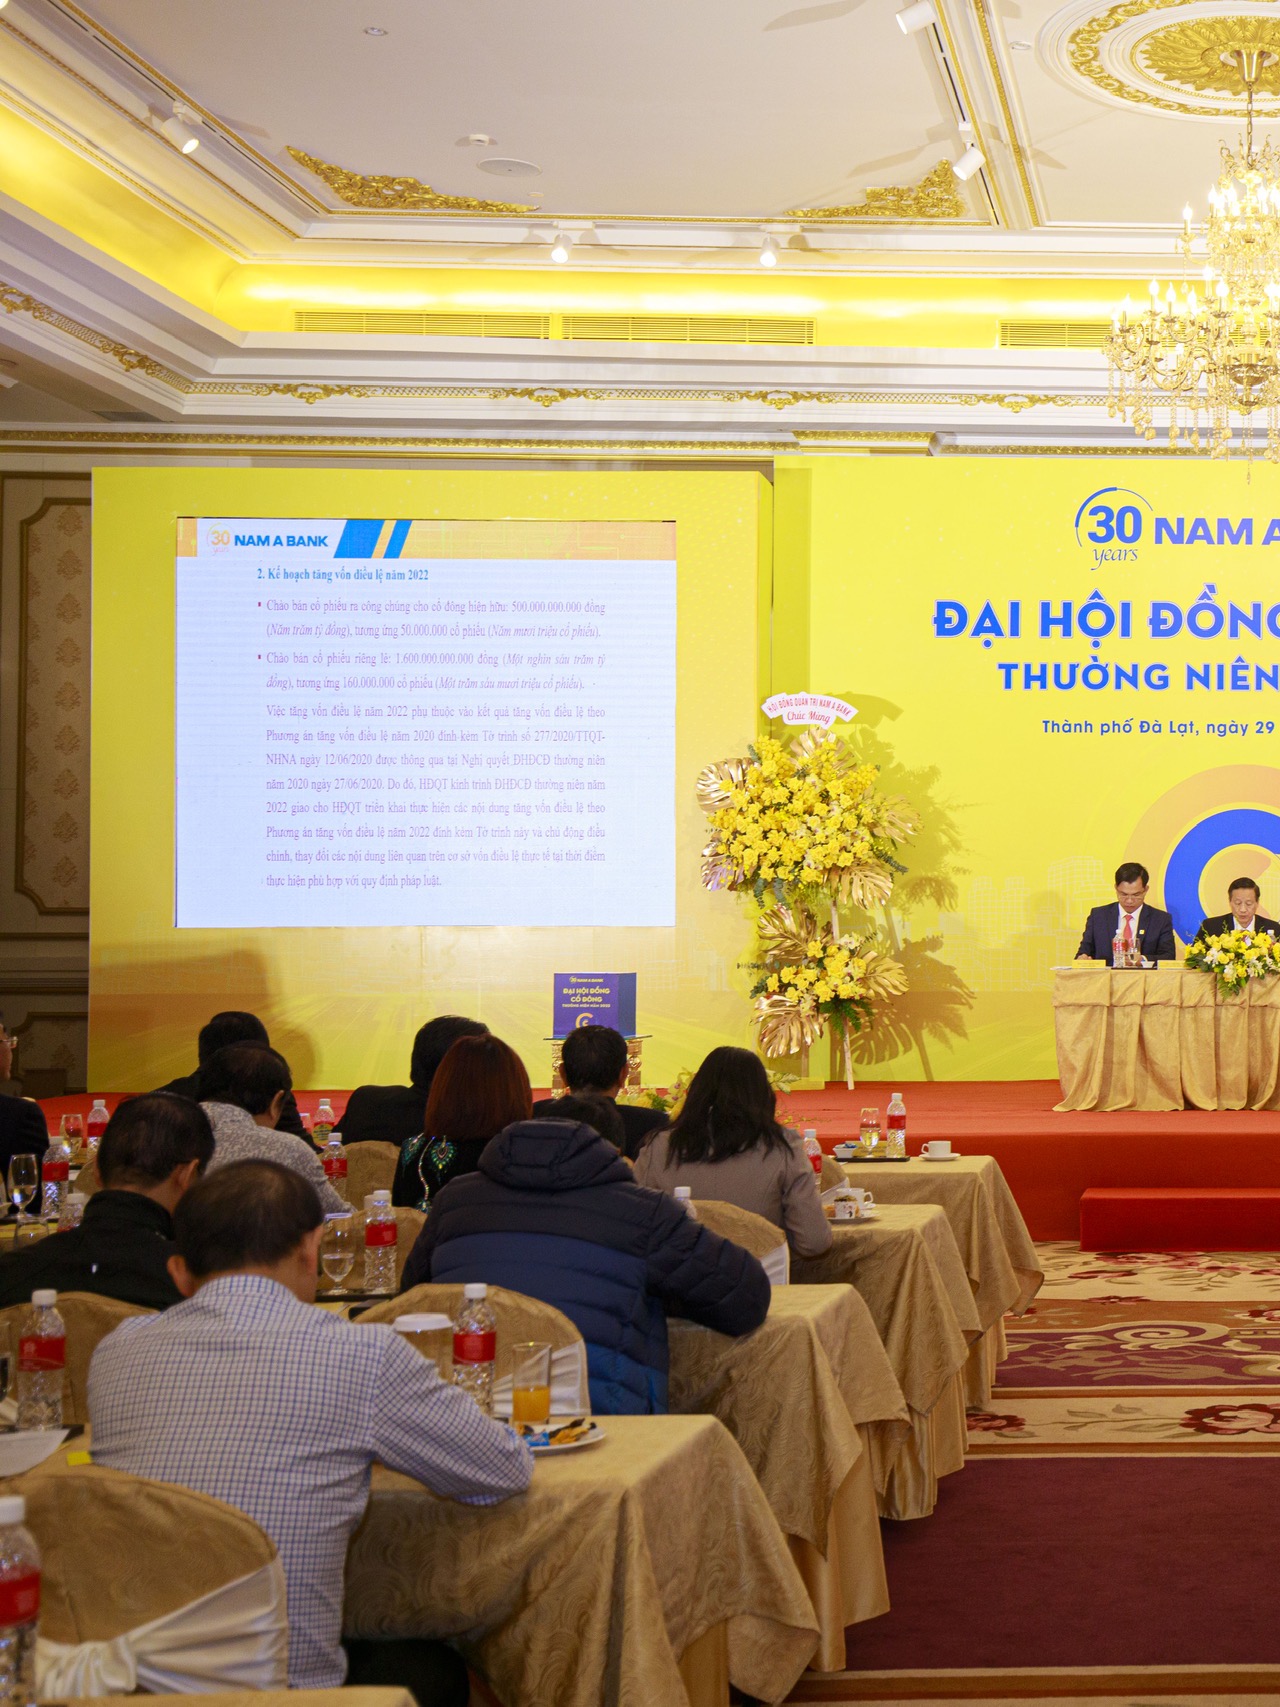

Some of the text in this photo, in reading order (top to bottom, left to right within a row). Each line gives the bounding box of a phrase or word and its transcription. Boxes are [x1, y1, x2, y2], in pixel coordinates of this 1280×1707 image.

[1087, 504, 1142, 543] 30
[1155, 518, 1253, 545] NAM
[211, 529, 329, 547] 30 NAM A BANK
[1091, 547, 1139, 571] years
[257, 566, 428, 583] 2. Kế hoạch tăng vốn điều lệ năm 2022
[350, 604, 358, 612] ra
[413, 601, 429, 612] cho
[512, 601, 582, 612] 500.000.000.000
[932, 599, 1021, 650] ĐẠI
[1038, 588, 1132, 650] HỘI
[997, 654, 1170, 691] THƯỜNG
[1185, 655, 1280, 692] NIÊN
[819, 698, 832, 708] NAM
[836, 703, 853, 717] BANK
[1042, 720, 1093, 733] Thành
[1100, 718, 1134, 736] phố
[1139, 720, 1162, 733] Đà
[1169, 720, 1199, 737] Lạt,
[1206, 720, 1249, 737] ngày
[1255, 721, 1275, 734] 29
[266, 754, 296, 765] NHNA
[326, 754, 372, 765] 12/06/2020
[428, 757, 444, 768] qua
[361, 878, 377, 889] quy
